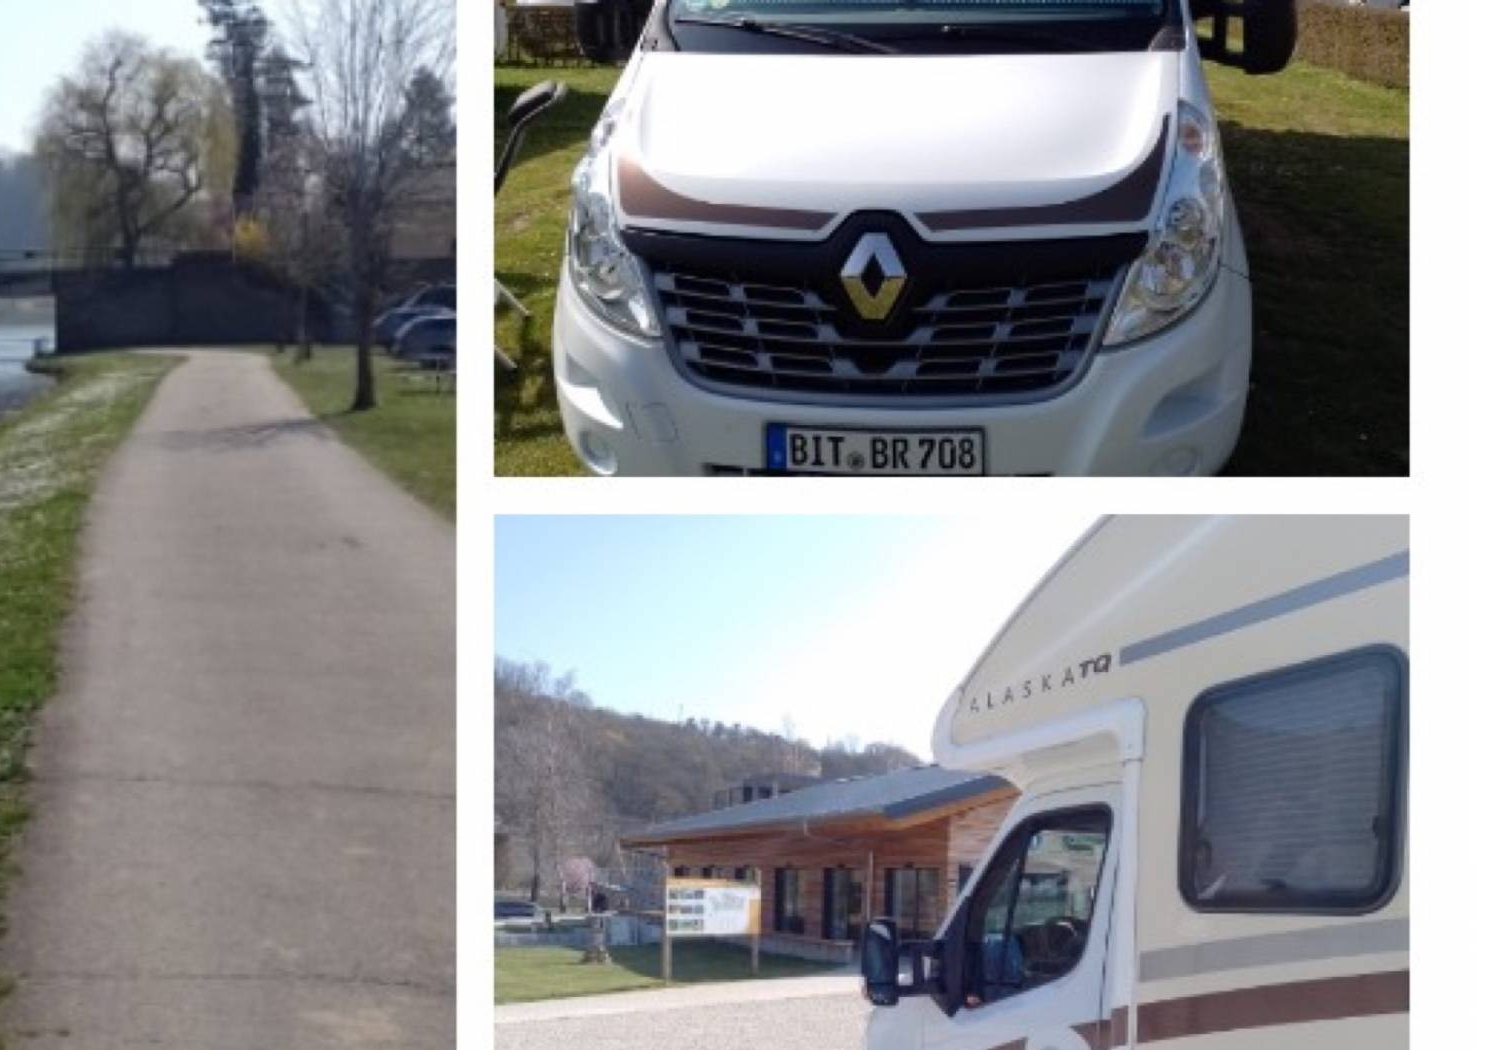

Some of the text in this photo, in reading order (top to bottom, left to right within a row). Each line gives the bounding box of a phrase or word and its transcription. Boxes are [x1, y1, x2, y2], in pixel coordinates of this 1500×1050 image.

[790, 433, 976, 470] BIT BR 708
[969, 665, 1075, 713] ALASKA
